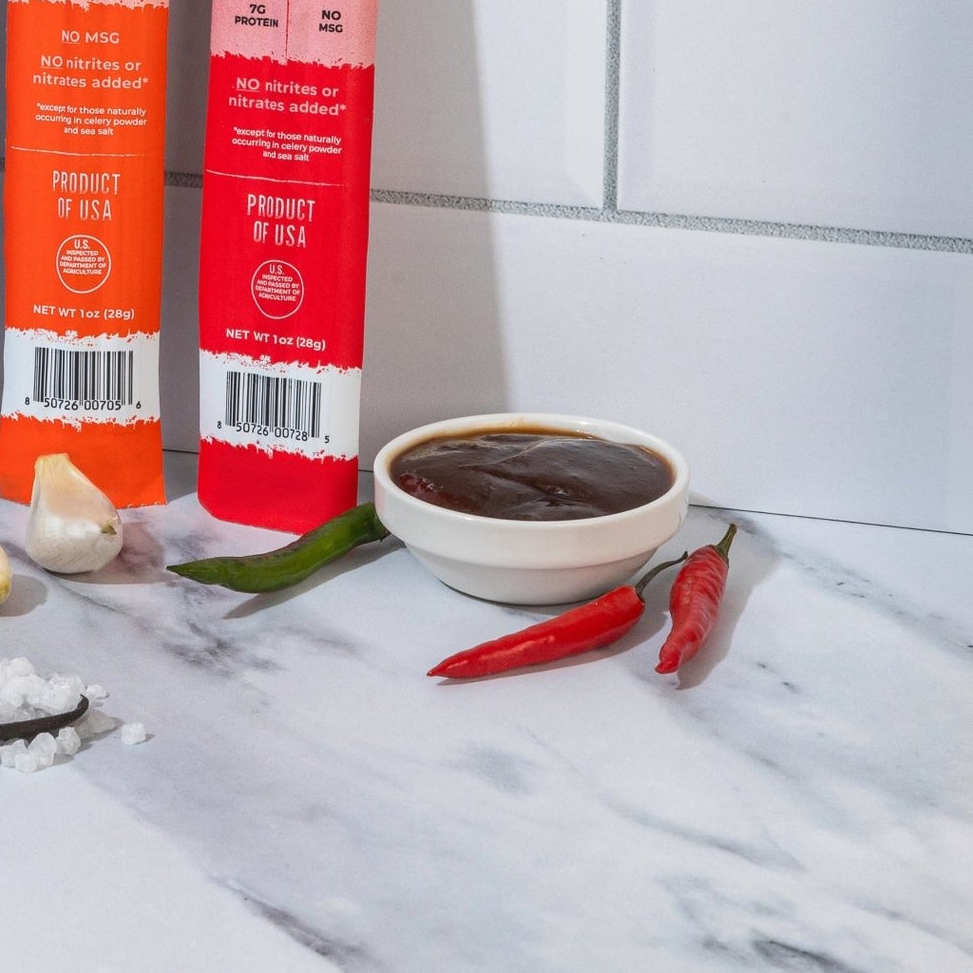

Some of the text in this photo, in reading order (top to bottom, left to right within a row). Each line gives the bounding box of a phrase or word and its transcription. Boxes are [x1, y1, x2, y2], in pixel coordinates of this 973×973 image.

[249, 4, 266, 15] 7G
[321, 10, 342, 21] NO
[235, 16, 279, 27] PROTEIN
[319, 23, 343, 33] MSG
[61, 30, 120, 44] NO MSG
[40, 55, 142, 71] NO nitrites or
[33, 72, 87, 87] nitrates
[235, 77, 339, 98] NO nitrites or
[229, 94, 285, 111] nitrates
[52, 170, 121, 195] PRODUCT
[58, 197, 112, 221] OF USA
[247, 194, 315, 222] PRODUCT
[253, 221, 307, 248] OF USA
[74, 239, 90, 249] U.S.
[33, 304, 56, 315] NET
[59, 308, 76, 317] WT
[104, 308, 135, 320] (28g)
[226, 328, 250, 339] NET
[254, 332, 270, 342] WT
[296, 336, 326, 351] (28g)
[25, 397, 142, 411] 8 50726 00705 6
[217, 421, 329, 444] 8 50726 00728 5
